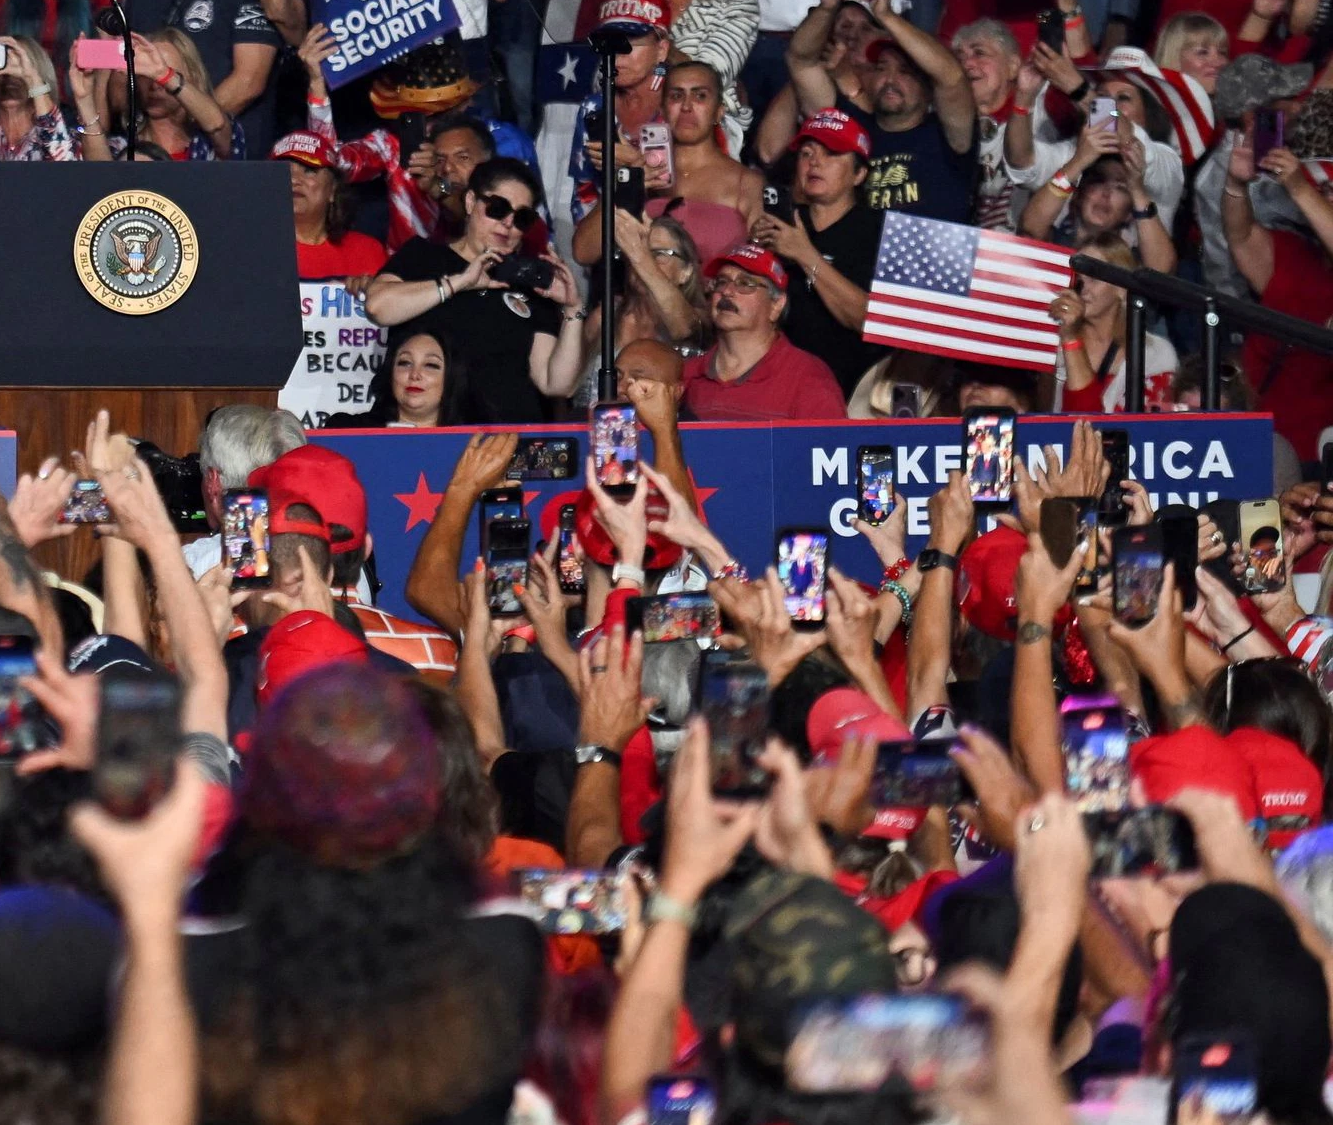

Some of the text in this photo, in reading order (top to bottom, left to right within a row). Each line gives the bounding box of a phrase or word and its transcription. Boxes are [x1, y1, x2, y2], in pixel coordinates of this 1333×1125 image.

[79, 195, 194, 311] PRESIDENT OF THE UNITED STATES
[81, 253, 127, 309] SEAL OF THE
[813, 447, 963, 486] MKE
[1261, 792, 1308, 807] TRUMP
